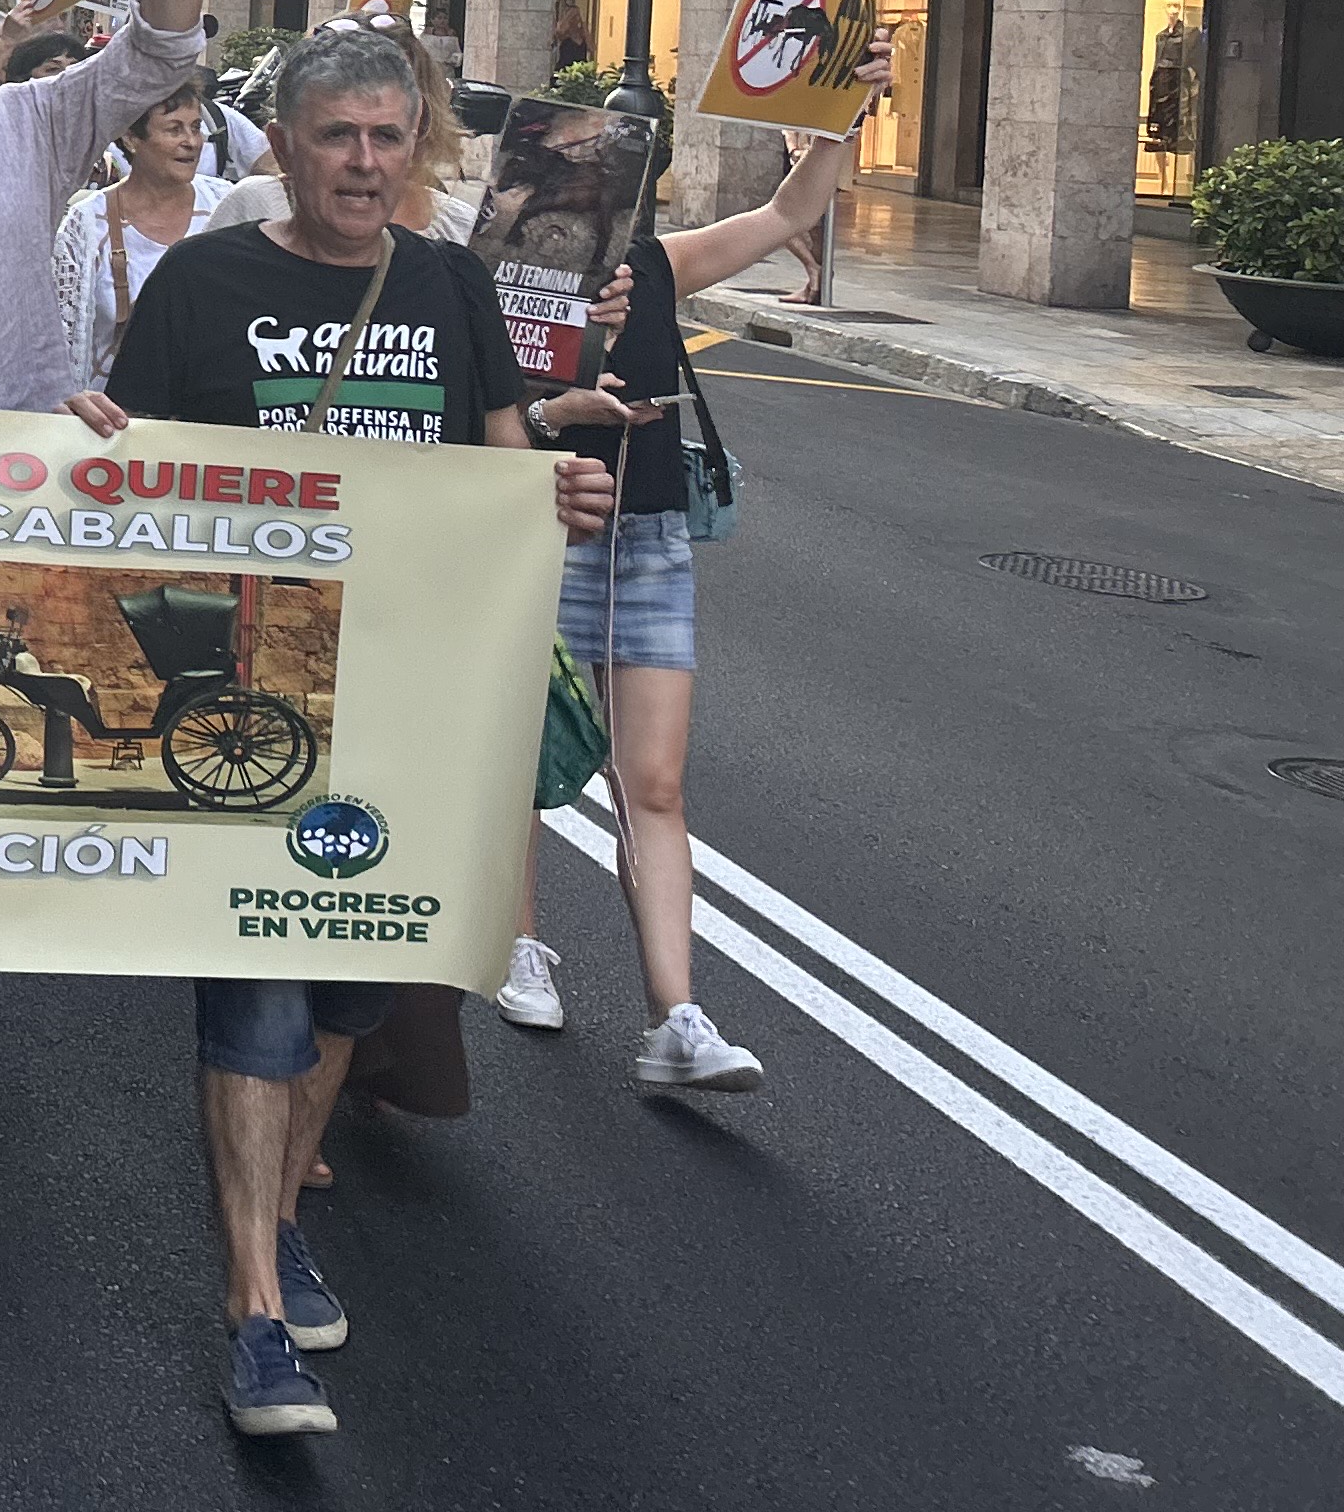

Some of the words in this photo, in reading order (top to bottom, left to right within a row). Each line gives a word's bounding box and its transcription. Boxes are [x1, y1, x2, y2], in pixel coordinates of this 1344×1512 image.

[517, 264, 584, 295] TERMINAN
[508, 293, 554, 319] PASEOS
[554, 301, 572, 322] EN
[315, 349, 440, 380] nturalis
[258, 407, 298, 425] POR
[326, 406, 411, 428] DEFENSA
[423, 413, 443, 432] DE
[353, 424, 442, 445] ANIMALES
[70, 456, 343, 512] QUIERE
[286, 792, 341, 831] PROGRESO
[344, 794, 364, 805] EN
[364, 802, 391, 835] VERDE
[228, 886, 442, 917] PROGRESO
[238, 916, 288, 939] EN
[299, 917, 430, 944] VERDE
